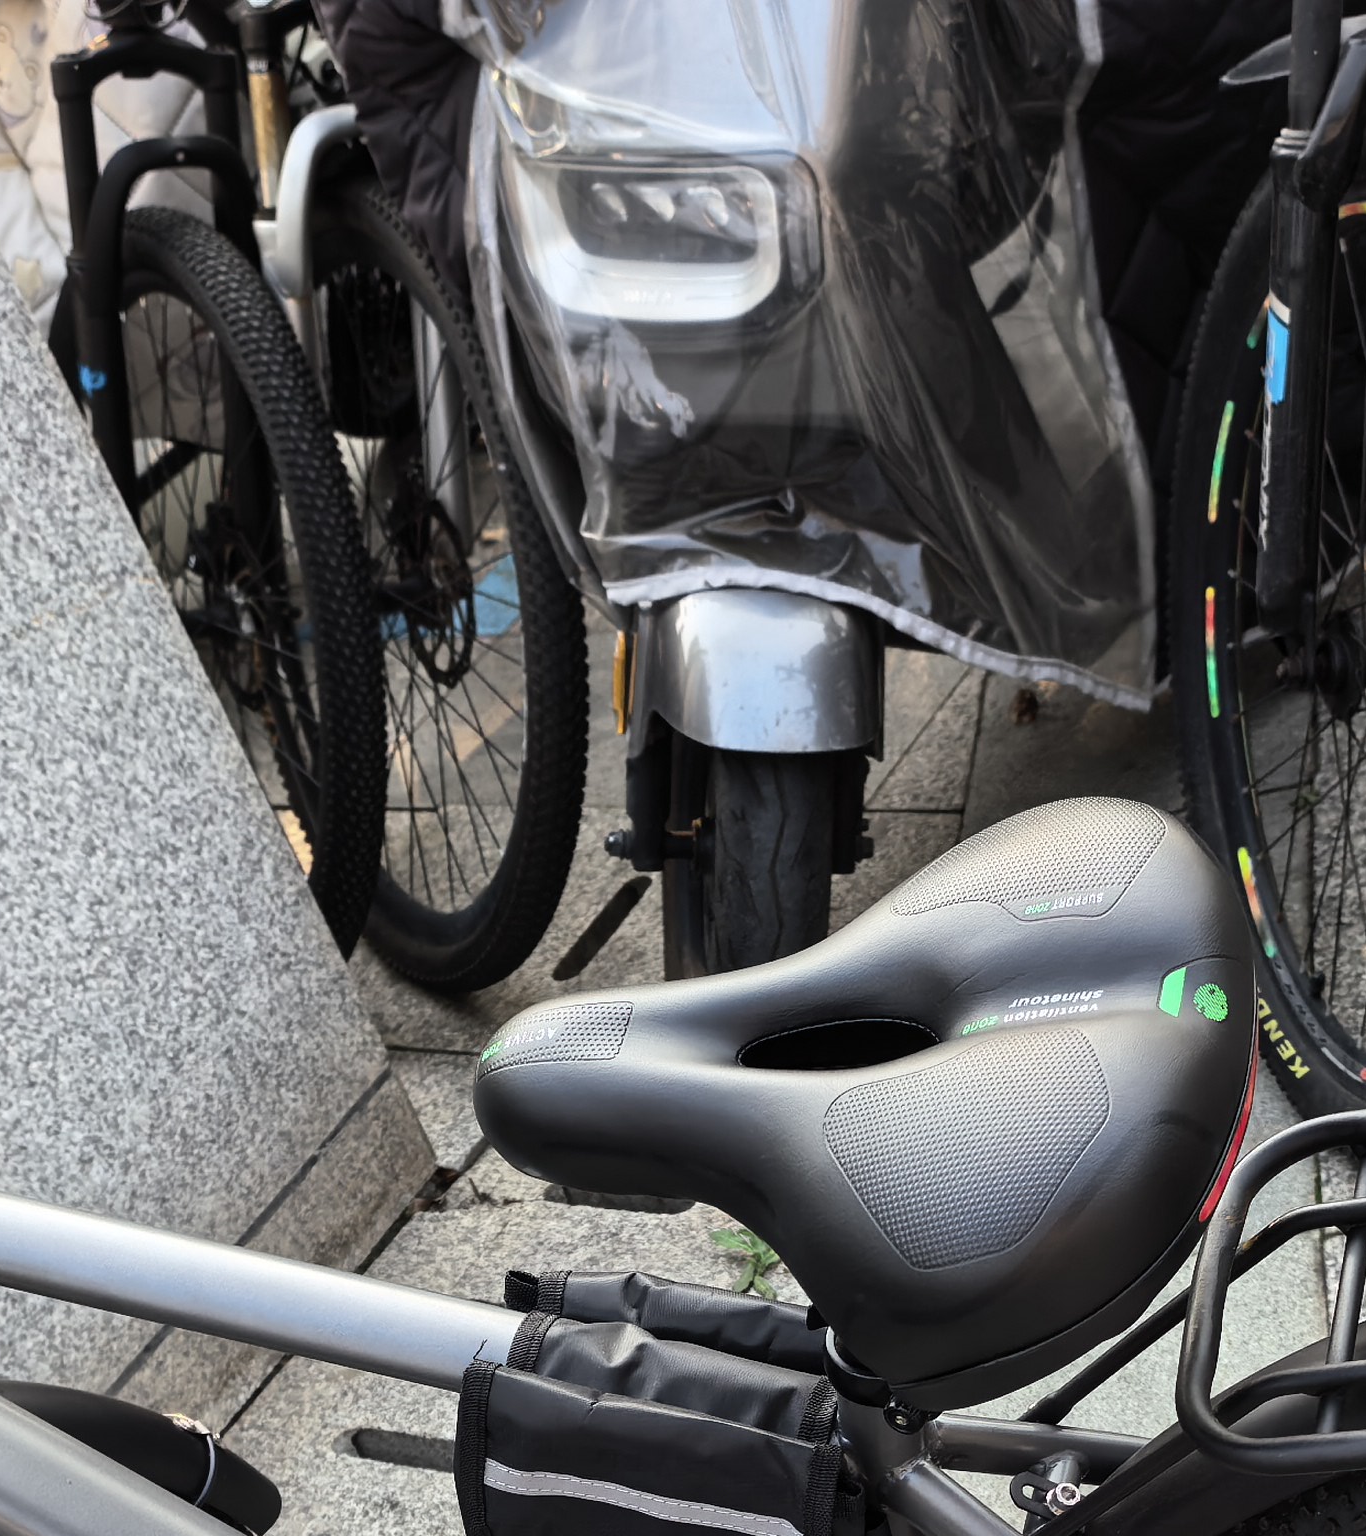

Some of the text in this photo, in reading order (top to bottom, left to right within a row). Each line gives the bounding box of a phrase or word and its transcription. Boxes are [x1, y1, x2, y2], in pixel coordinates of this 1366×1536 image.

[1051, 892, 1104, 911] SUPPORT
[1008, 989, 1104, 1009] shinetour
[1003, 1003, 1099, 1023] ventilation
[503, 1027, 559, 1049] ACTIVE
[1256, 986, 1312, 1080] KEND
